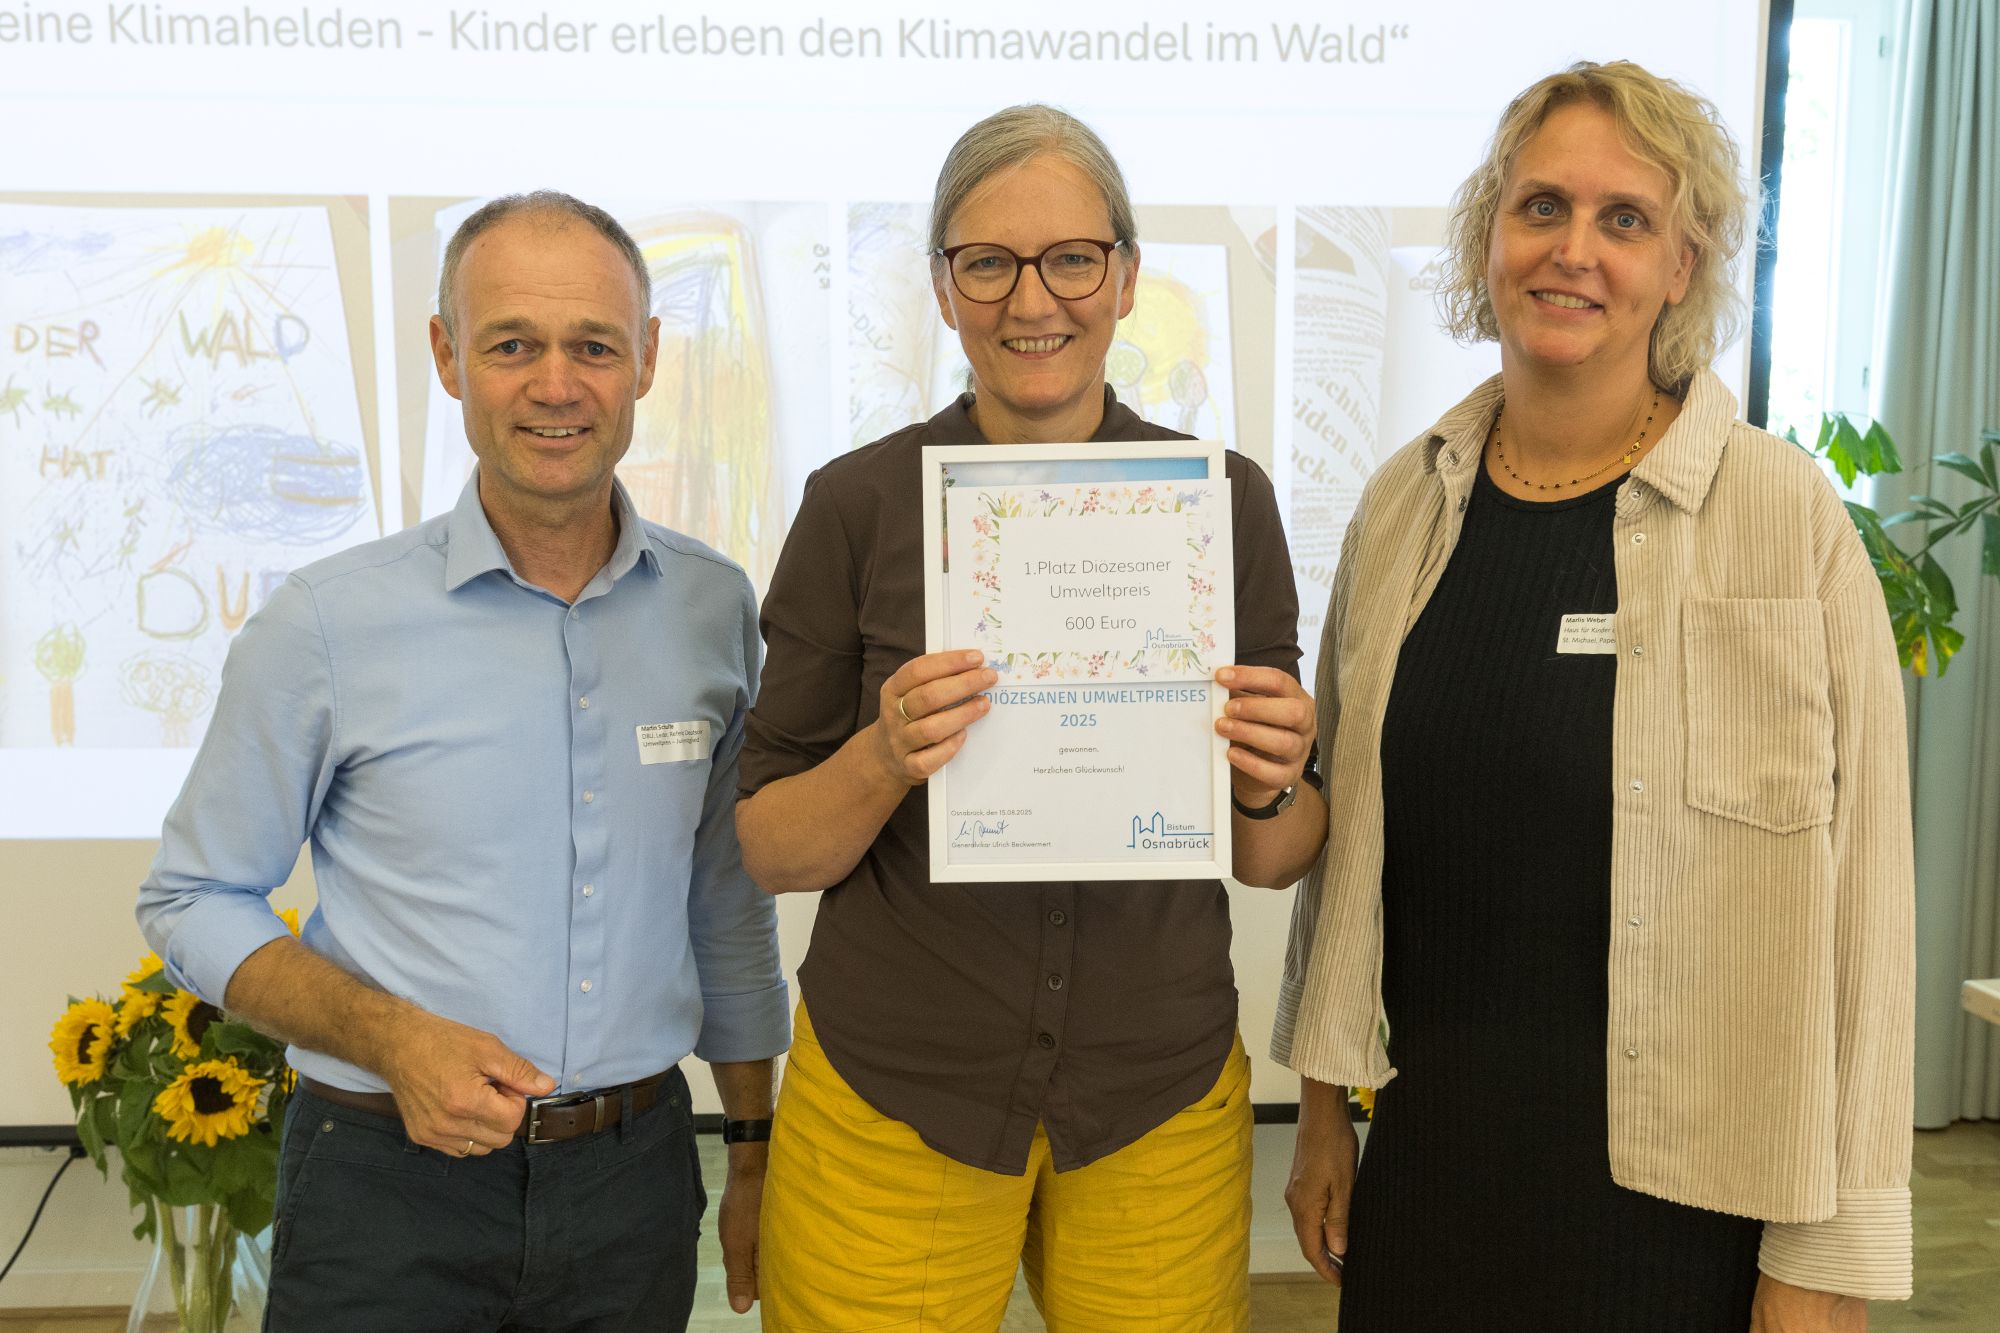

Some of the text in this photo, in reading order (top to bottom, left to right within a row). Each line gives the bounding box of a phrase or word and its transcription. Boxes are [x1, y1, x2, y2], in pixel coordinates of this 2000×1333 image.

[0, 1, 93, 44] eine
[107, 2, 403, 49] Klimahelden
[449, 9, 598, 53] Kinder
[610, 13, 785, 57] erleben
[799, 16, 884, 59] den
[898, 17, 1192, 63] Klimawandel
[1206, 21, 1258, 63] im
[12, 308, 310, 370] DER WALD
[39, 442, 114, 480] HAT
[1024, 558, 1172, 576] 1.Platz Diözesaner
[1050, 583, 1151, 600] Umweltpreis
[1065, 615, 1137, 630] 600 Euro
[1151, 640, 1190, 650] Osnabrück
[1082, 688, 1207, 704] UMWELTPREISES
[1060, 713, 1097, 727] 2025
[1058, 746, 1100, 755] gewonnen.
[1033, 765, 1125, 775] Herzlichen Glückwunsch!
[1166, 823, 1196, 831] Bistum
[1142, 837, 1210, 850] Osnabrück
